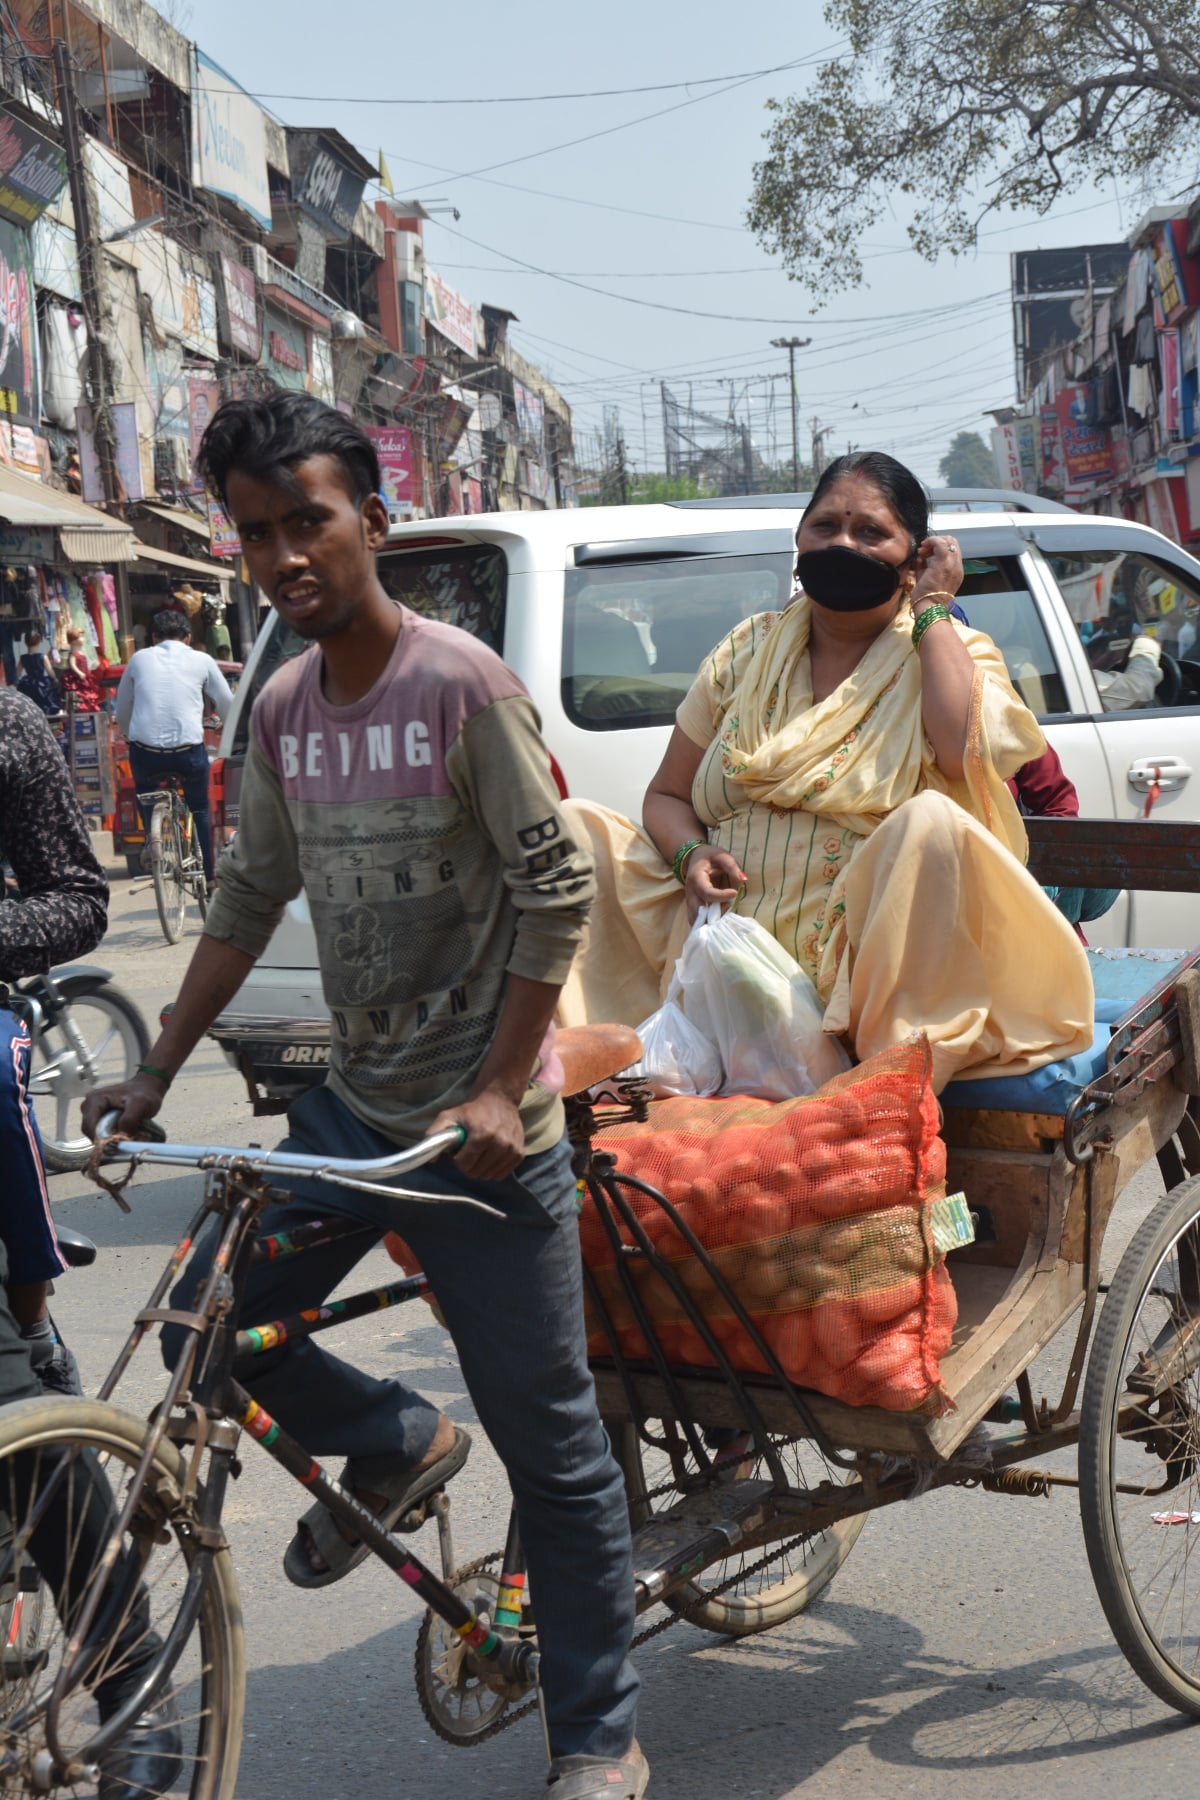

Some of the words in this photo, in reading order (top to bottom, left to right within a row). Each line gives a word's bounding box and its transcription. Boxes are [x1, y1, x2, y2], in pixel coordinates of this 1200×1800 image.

[280, 720, 432, 778] BEING
[325, 859, 455, 897] EING
[333, 986, 467, 1037] UMAN
